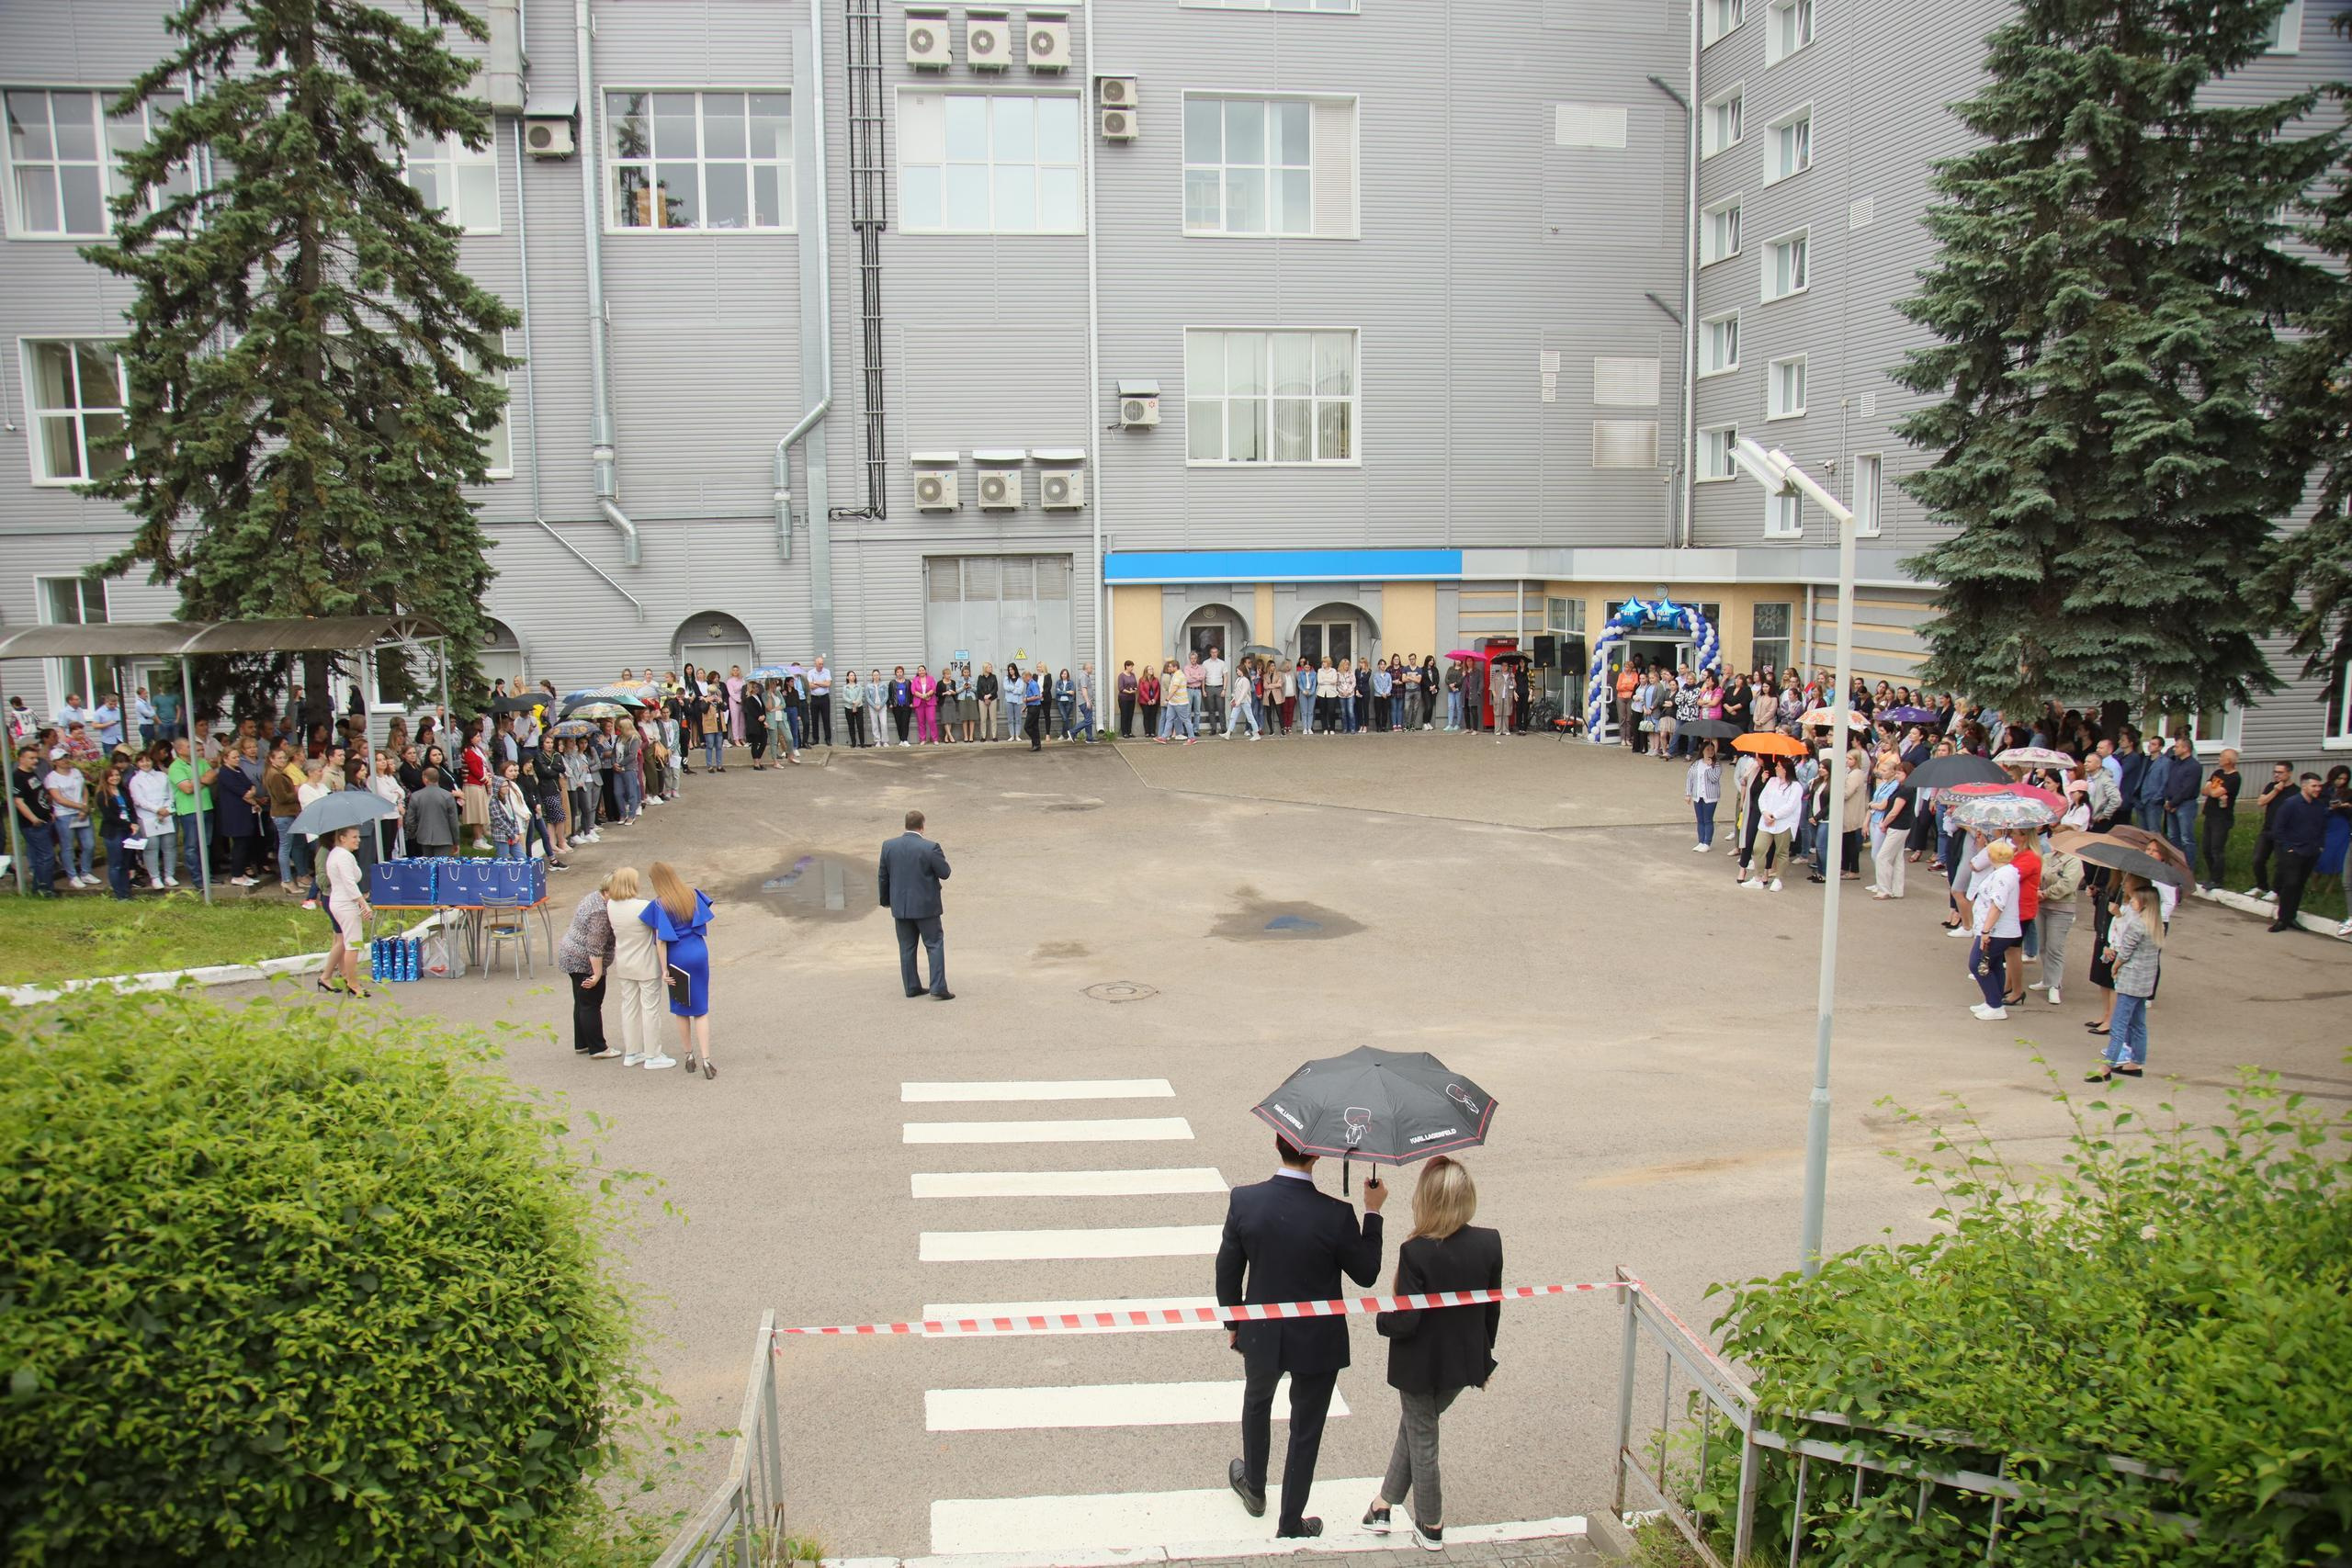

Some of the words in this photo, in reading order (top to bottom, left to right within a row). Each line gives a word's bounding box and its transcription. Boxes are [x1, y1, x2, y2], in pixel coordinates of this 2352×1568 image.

[1273, 1103, 1285, 1115] KARL
[1283, 1111, 1304, 1130] LAGERFELD
[1409, 1135, 1426, 1145] KARL
[1424, 1128, 1457, 1140] LAGERFELD
